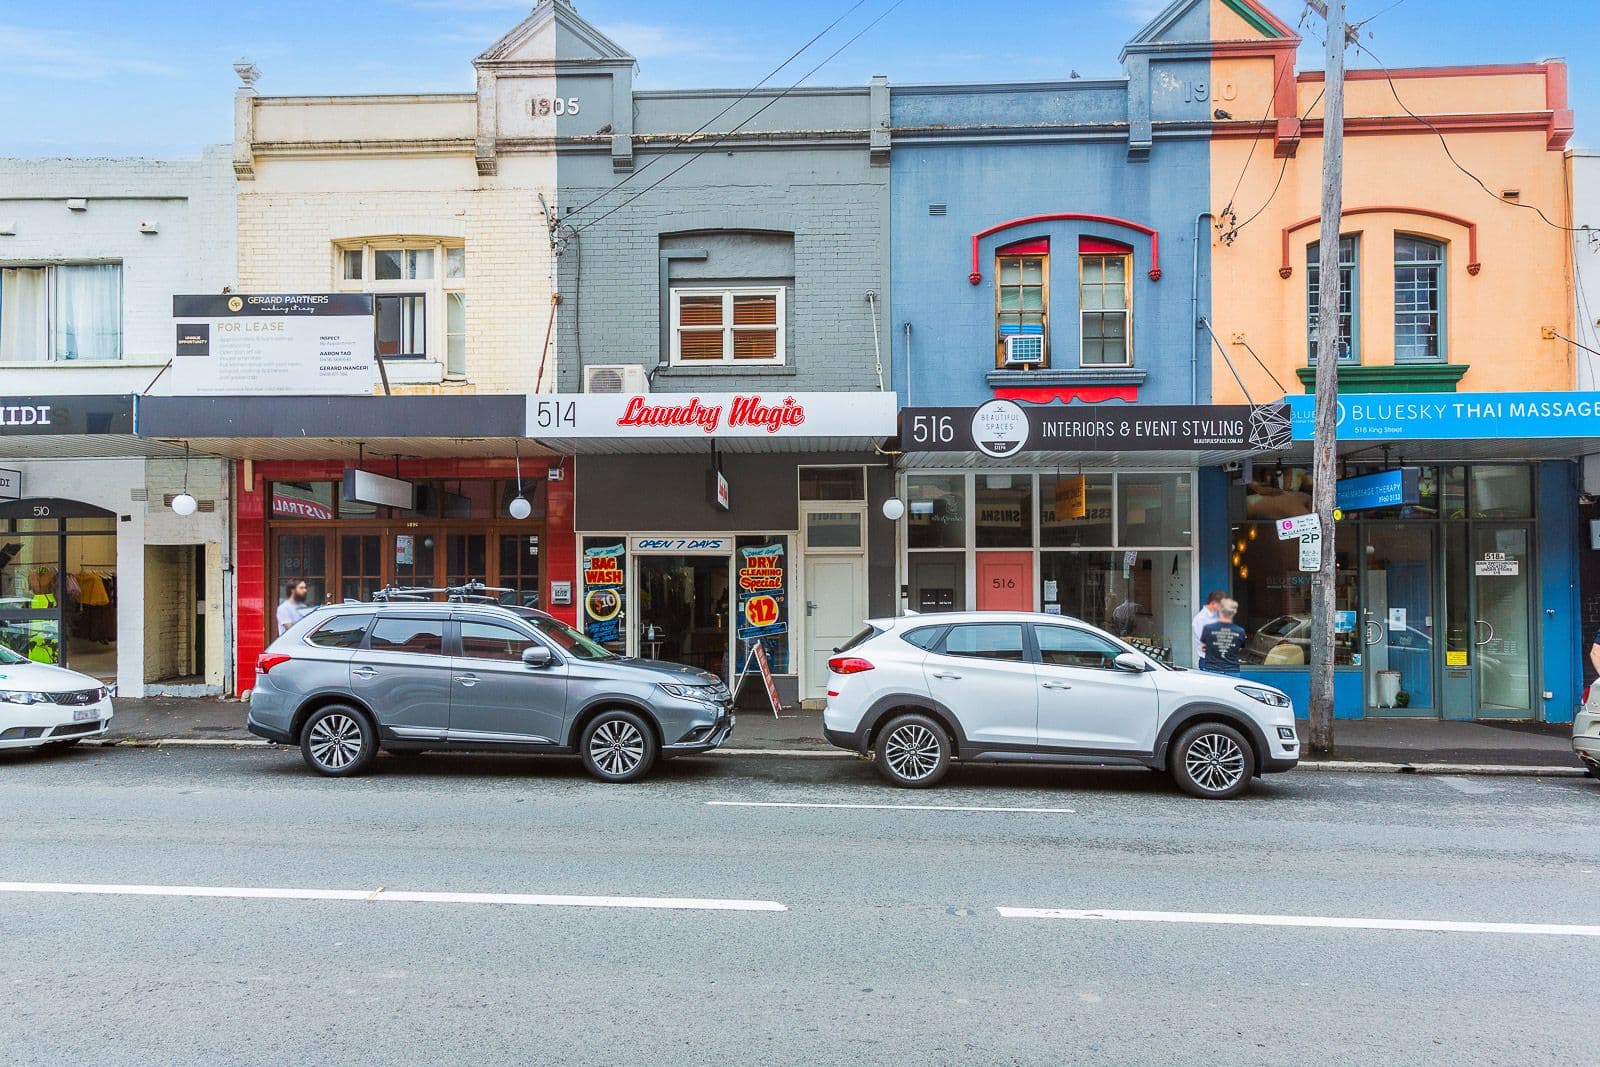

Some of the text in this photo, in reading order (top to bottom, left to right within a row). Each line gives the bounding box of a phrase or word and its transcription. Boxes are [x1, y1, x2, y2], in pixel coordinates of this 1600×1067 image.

[530, 97, 580, 116] 1905
[247, 295, 329, 304] GERARD PARTNERS
[218, 322, 284, 332] FOR LEASE
[537, 401, 578, 428] 514
[616, 396, 806, 433] Laundry Magic
[1352, 402, 1600, 420] BLUESKY THAI MASSAGE
[913, 415, 954, 442] 516
[1042, 420, 1244, 438] INTERIORS & EVENT STYLING
[1376, 483, 1400, 494] THERAPY
[34, 506, 50, 516] 510
[638, 540, 722, 549] OPEN 7 DAYS
[1302, 534, 1319, 544] 2P
[591, 556, 616, 570] BAG
[748, 556, 777, 568] DRY
[585, 570, 622, 584] WASH
[992, 578, 1015, 589] 516
[740, 577, 781, 592] Special
